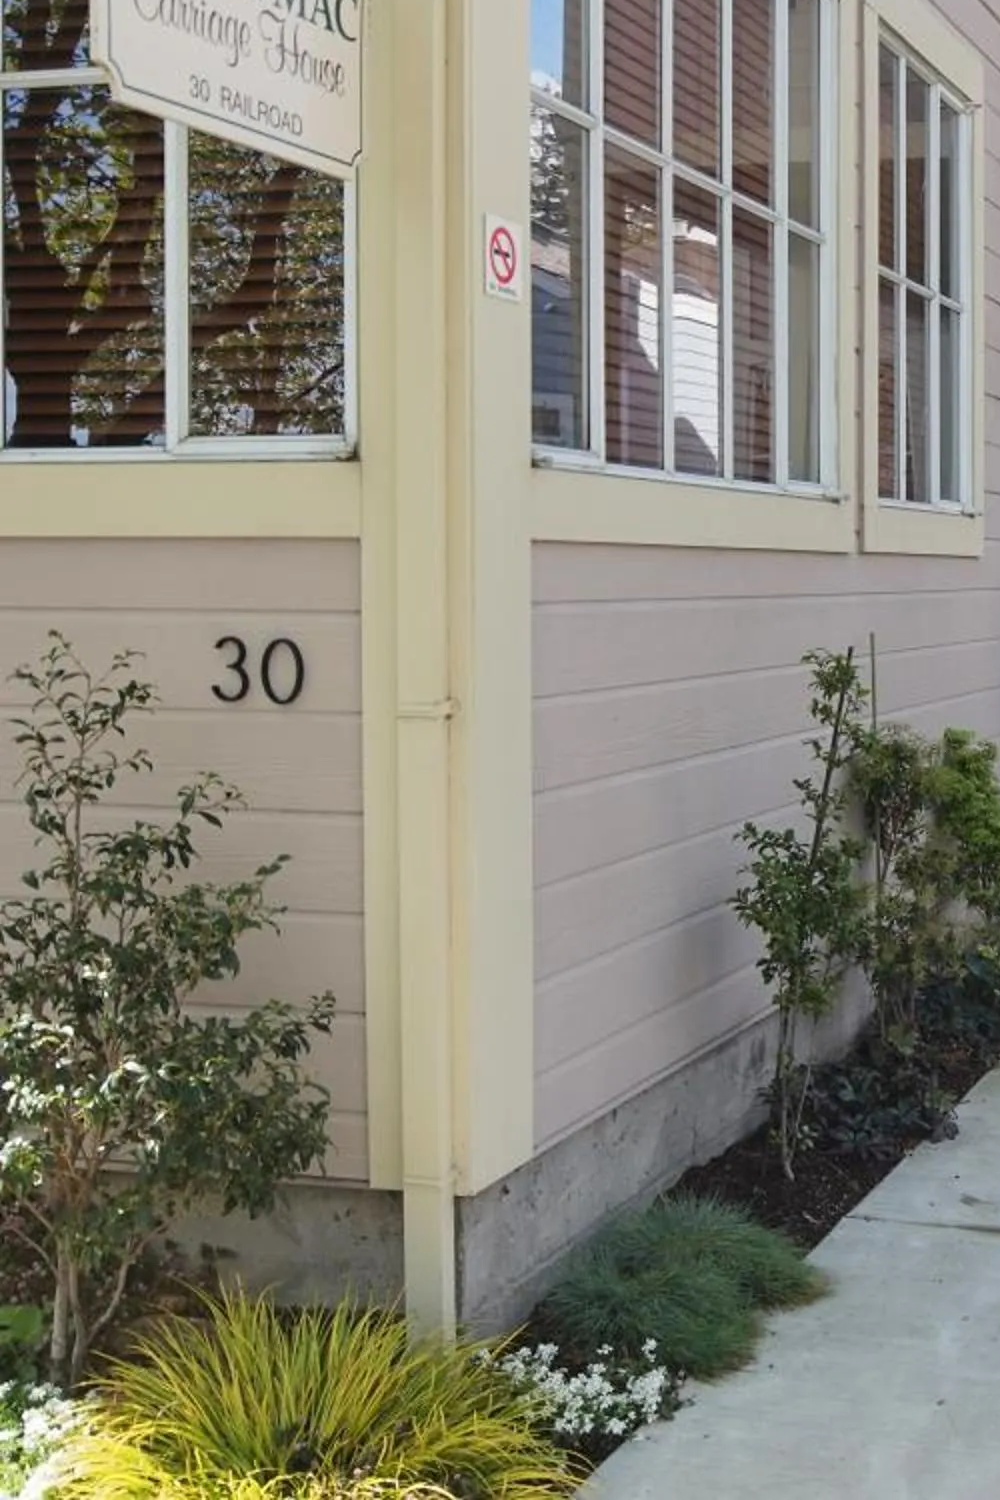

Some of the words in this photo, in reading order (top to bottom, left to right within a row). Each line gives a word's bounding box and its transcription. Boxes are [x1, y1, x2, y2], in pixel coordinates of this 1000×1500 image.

[260, 9, 345, 97] House
[189, 73, 211, 102] 30
[220, 85, 303, 137] RAILROAD
[211, 636, 305, 705] 30
